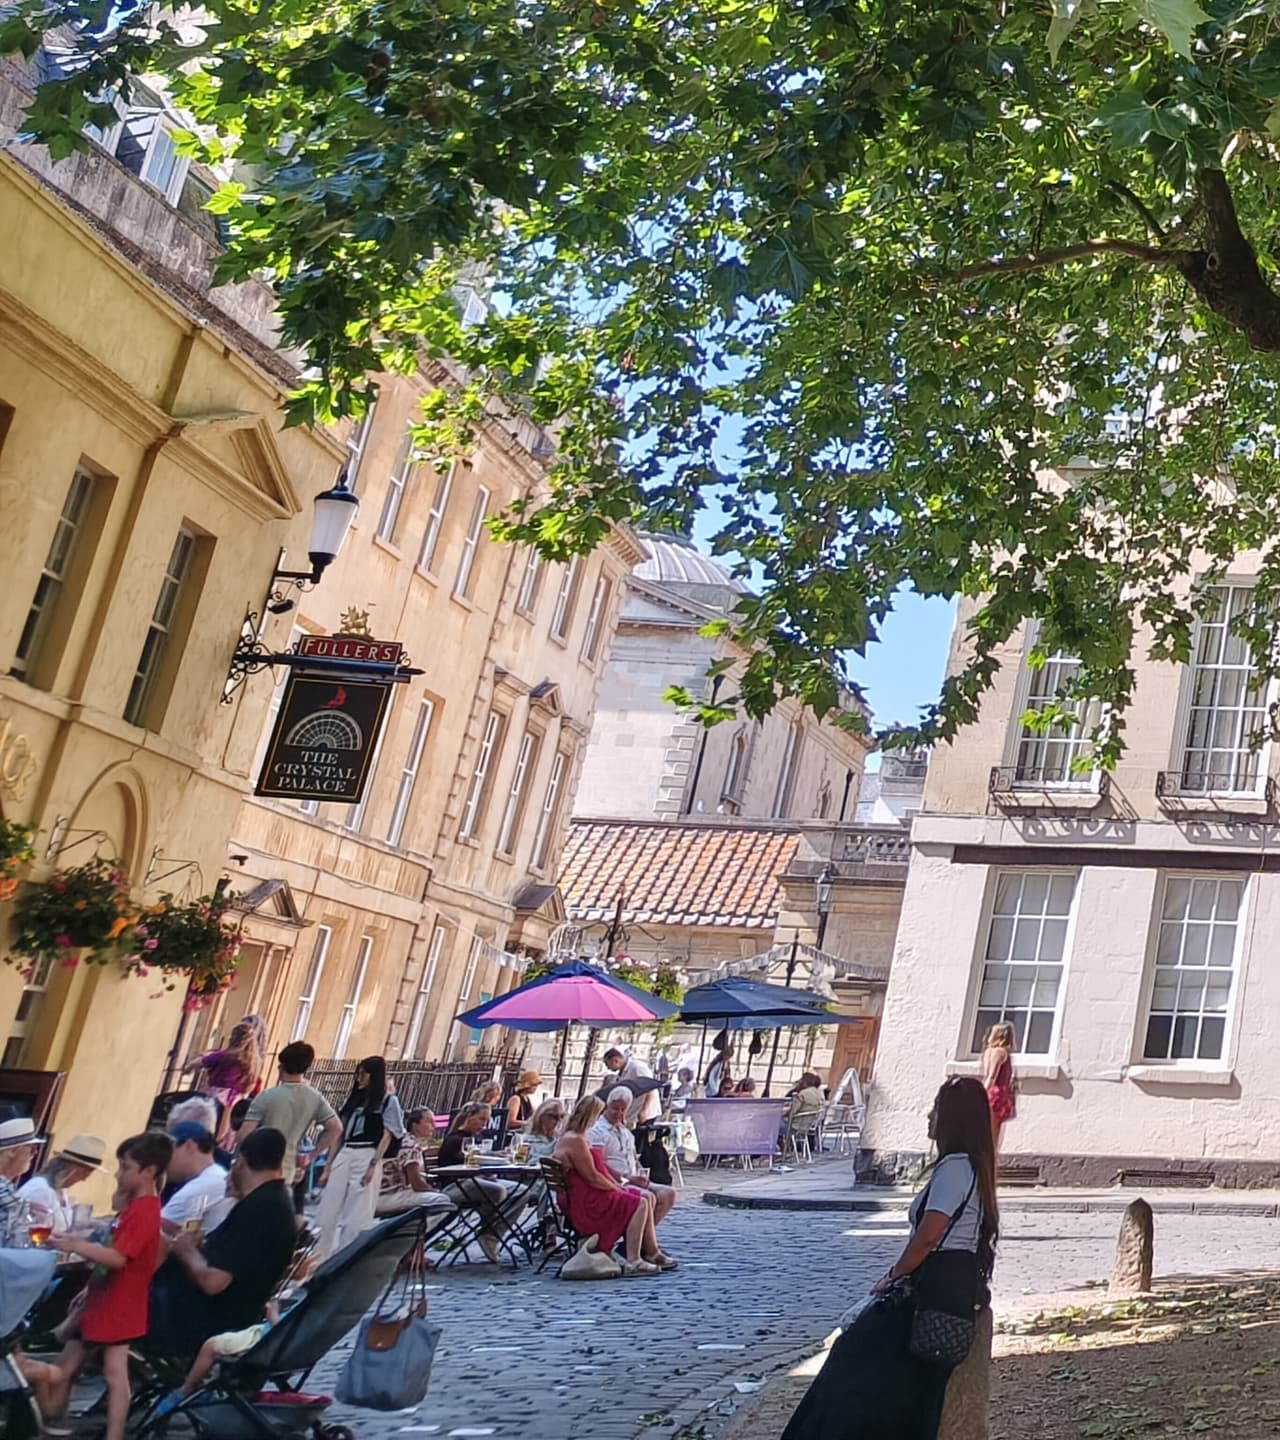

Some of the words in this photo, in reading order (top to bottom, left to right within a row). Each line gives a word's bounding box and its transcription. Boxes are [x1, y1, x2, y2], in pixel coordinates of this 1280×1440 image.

[301, 750, 338, 765] THE
[274, 763, 357, 780] CRYSTAL
[277, 776, 346, 792] PALACE
